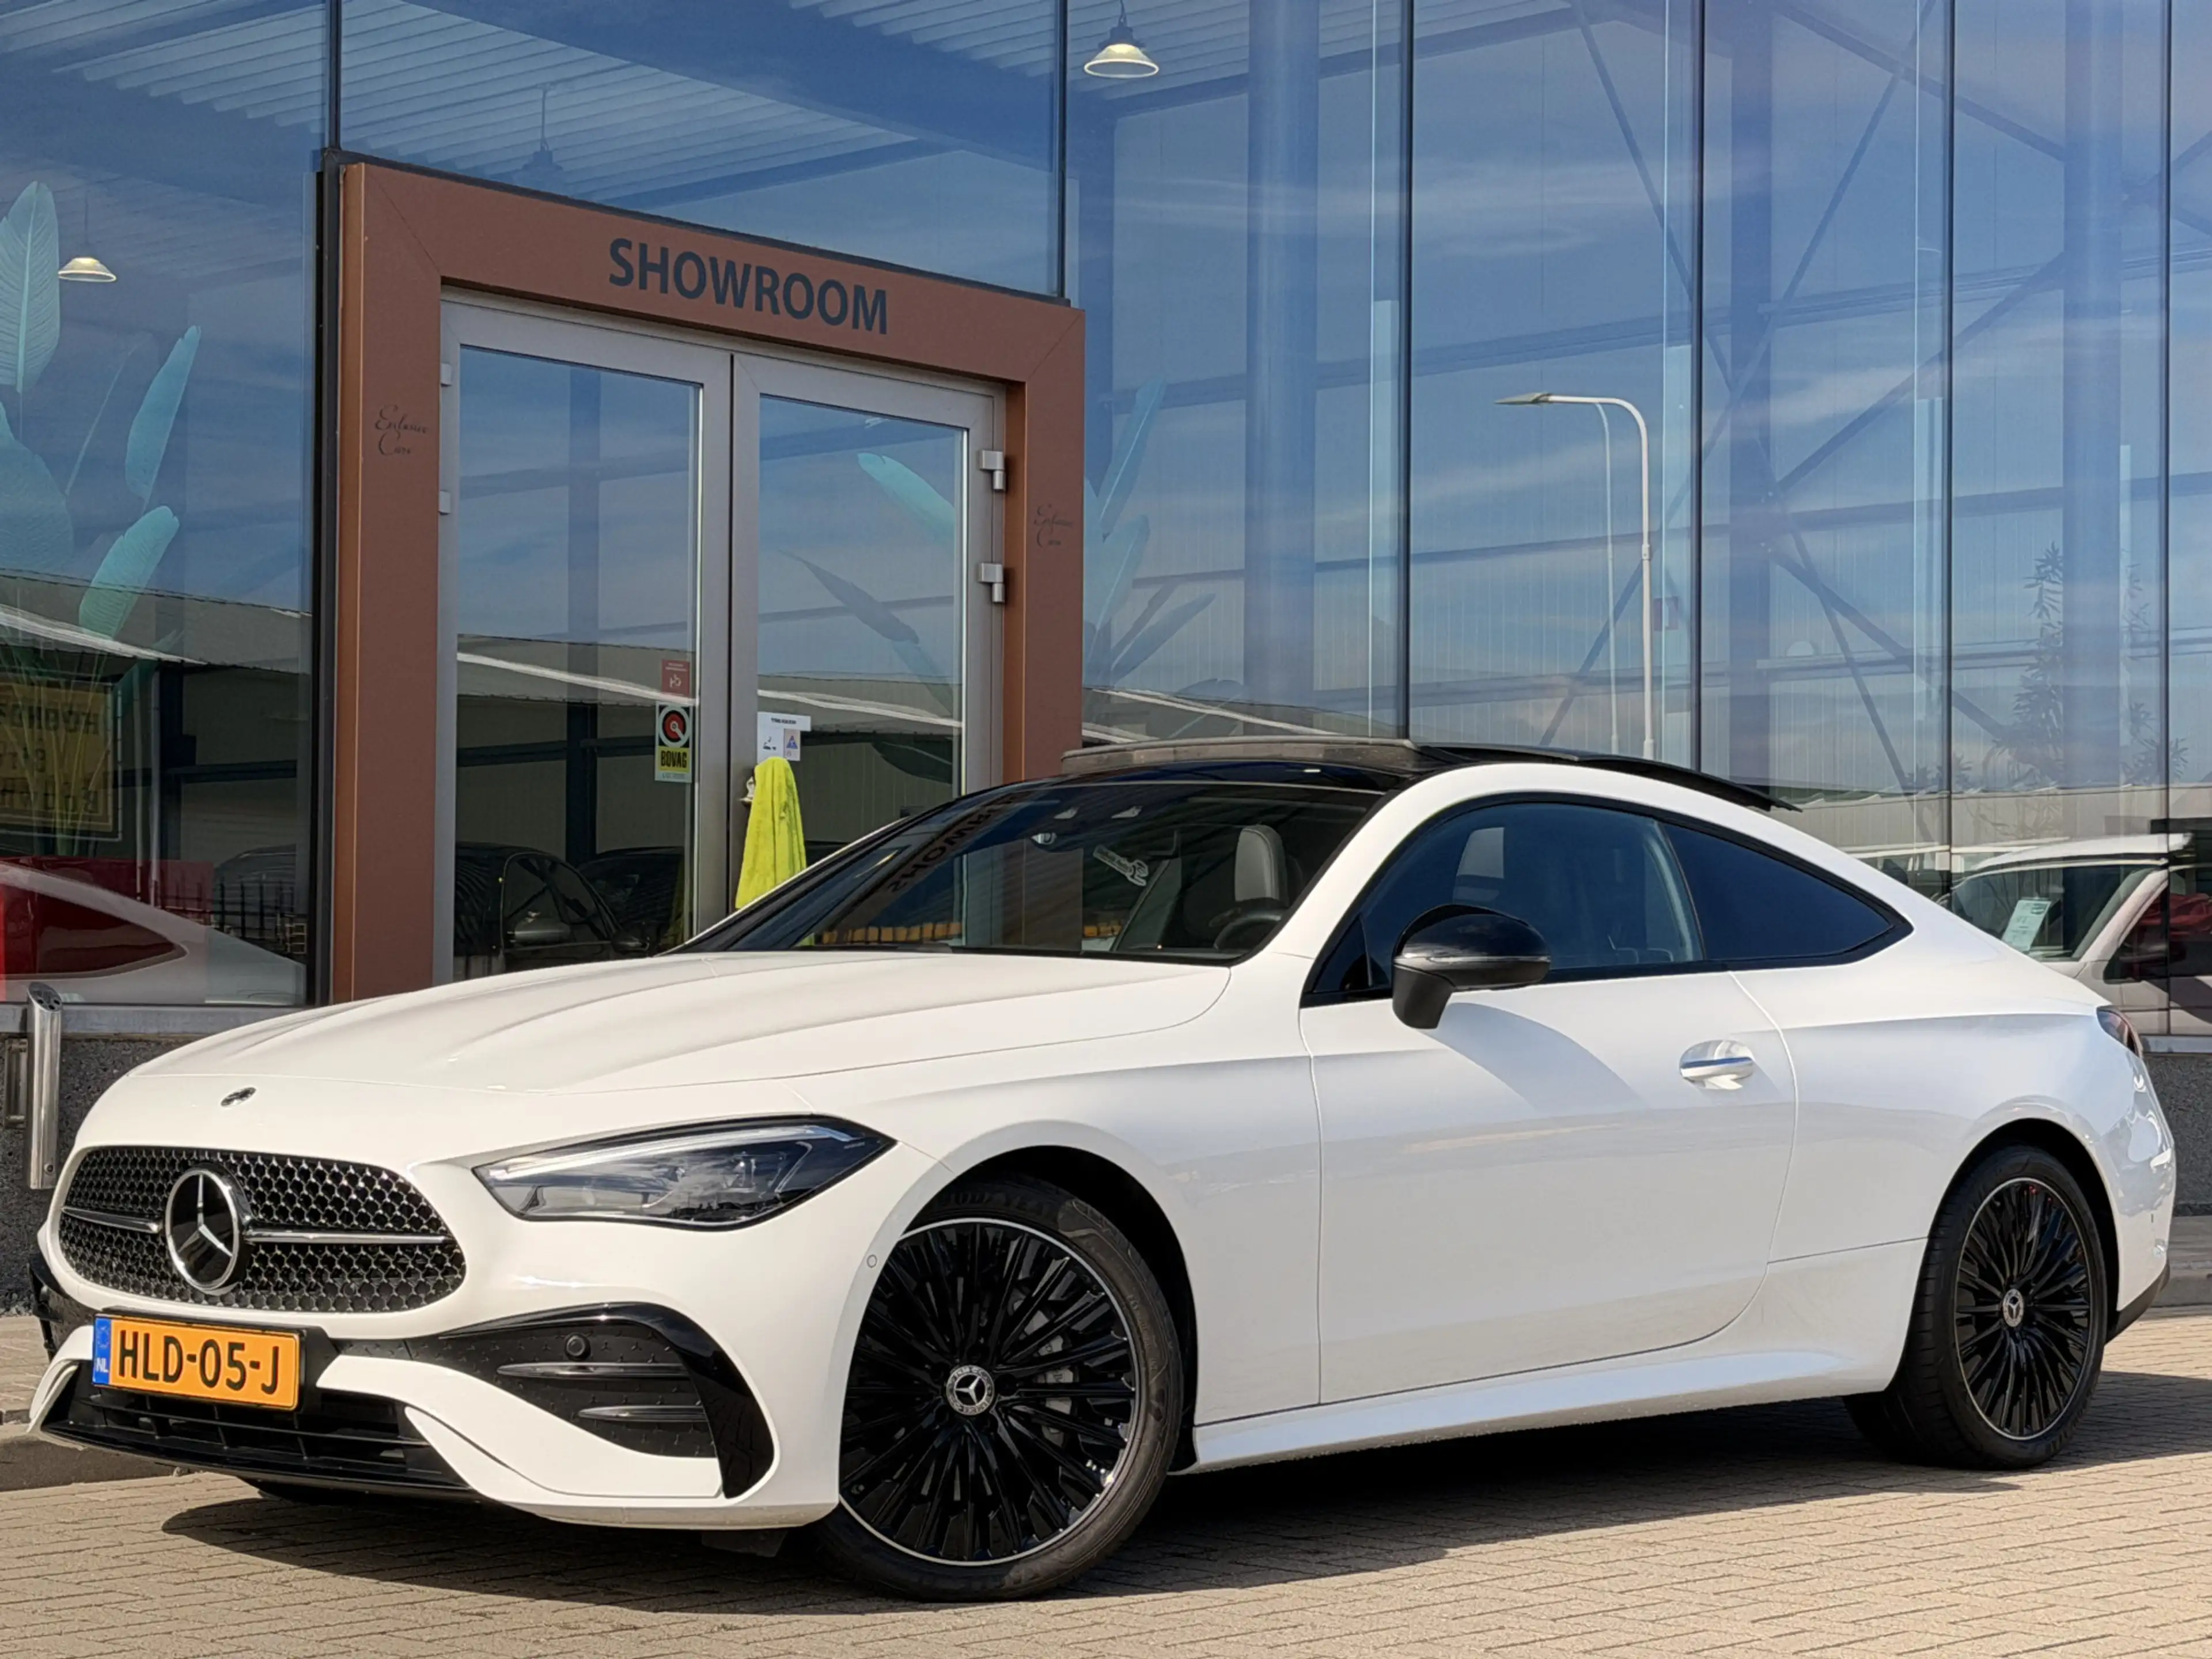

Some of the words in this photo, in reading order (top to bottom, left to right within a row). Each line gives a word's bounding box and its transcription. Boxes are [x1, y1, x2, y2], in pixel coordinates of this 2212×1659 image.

[609, 238, 888, 335] SHOWROOM
[661, 749, 687, 768] BOVAG
[94, 1357, 109, 1374] NL
[118, 1329, 280, 1395] HLD-05-J
